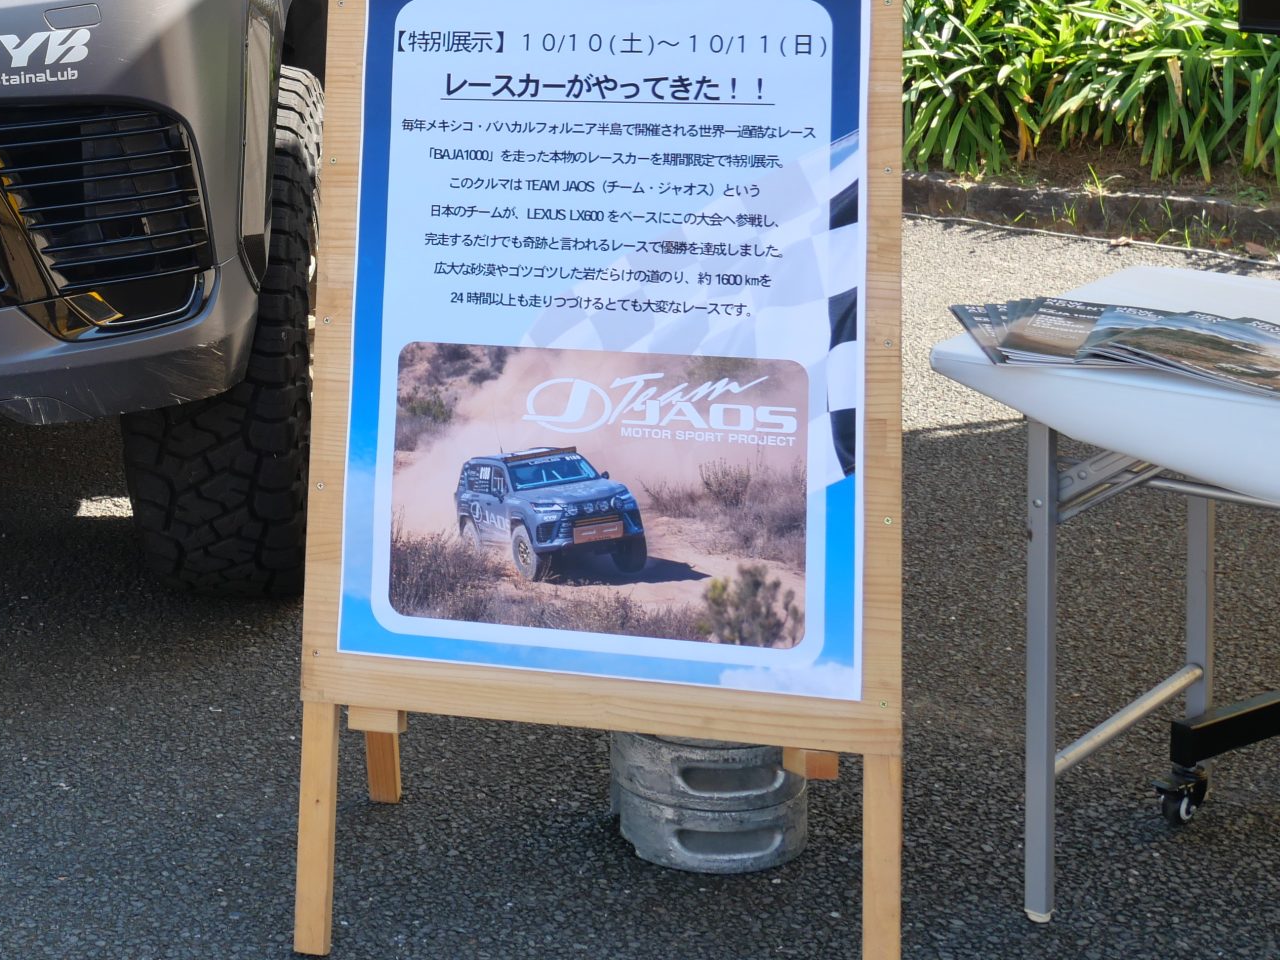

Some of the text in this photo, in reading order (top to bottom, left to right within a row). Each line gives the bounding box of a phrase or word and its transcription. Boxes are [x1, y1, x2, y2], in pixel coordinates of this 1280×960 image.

[446, 72, 764, 101] レースカーがやってきた！！
[622, 399, 797, 433] JAOS
[620, 427, 796, 447] MOTOR SPORT PROJECT
